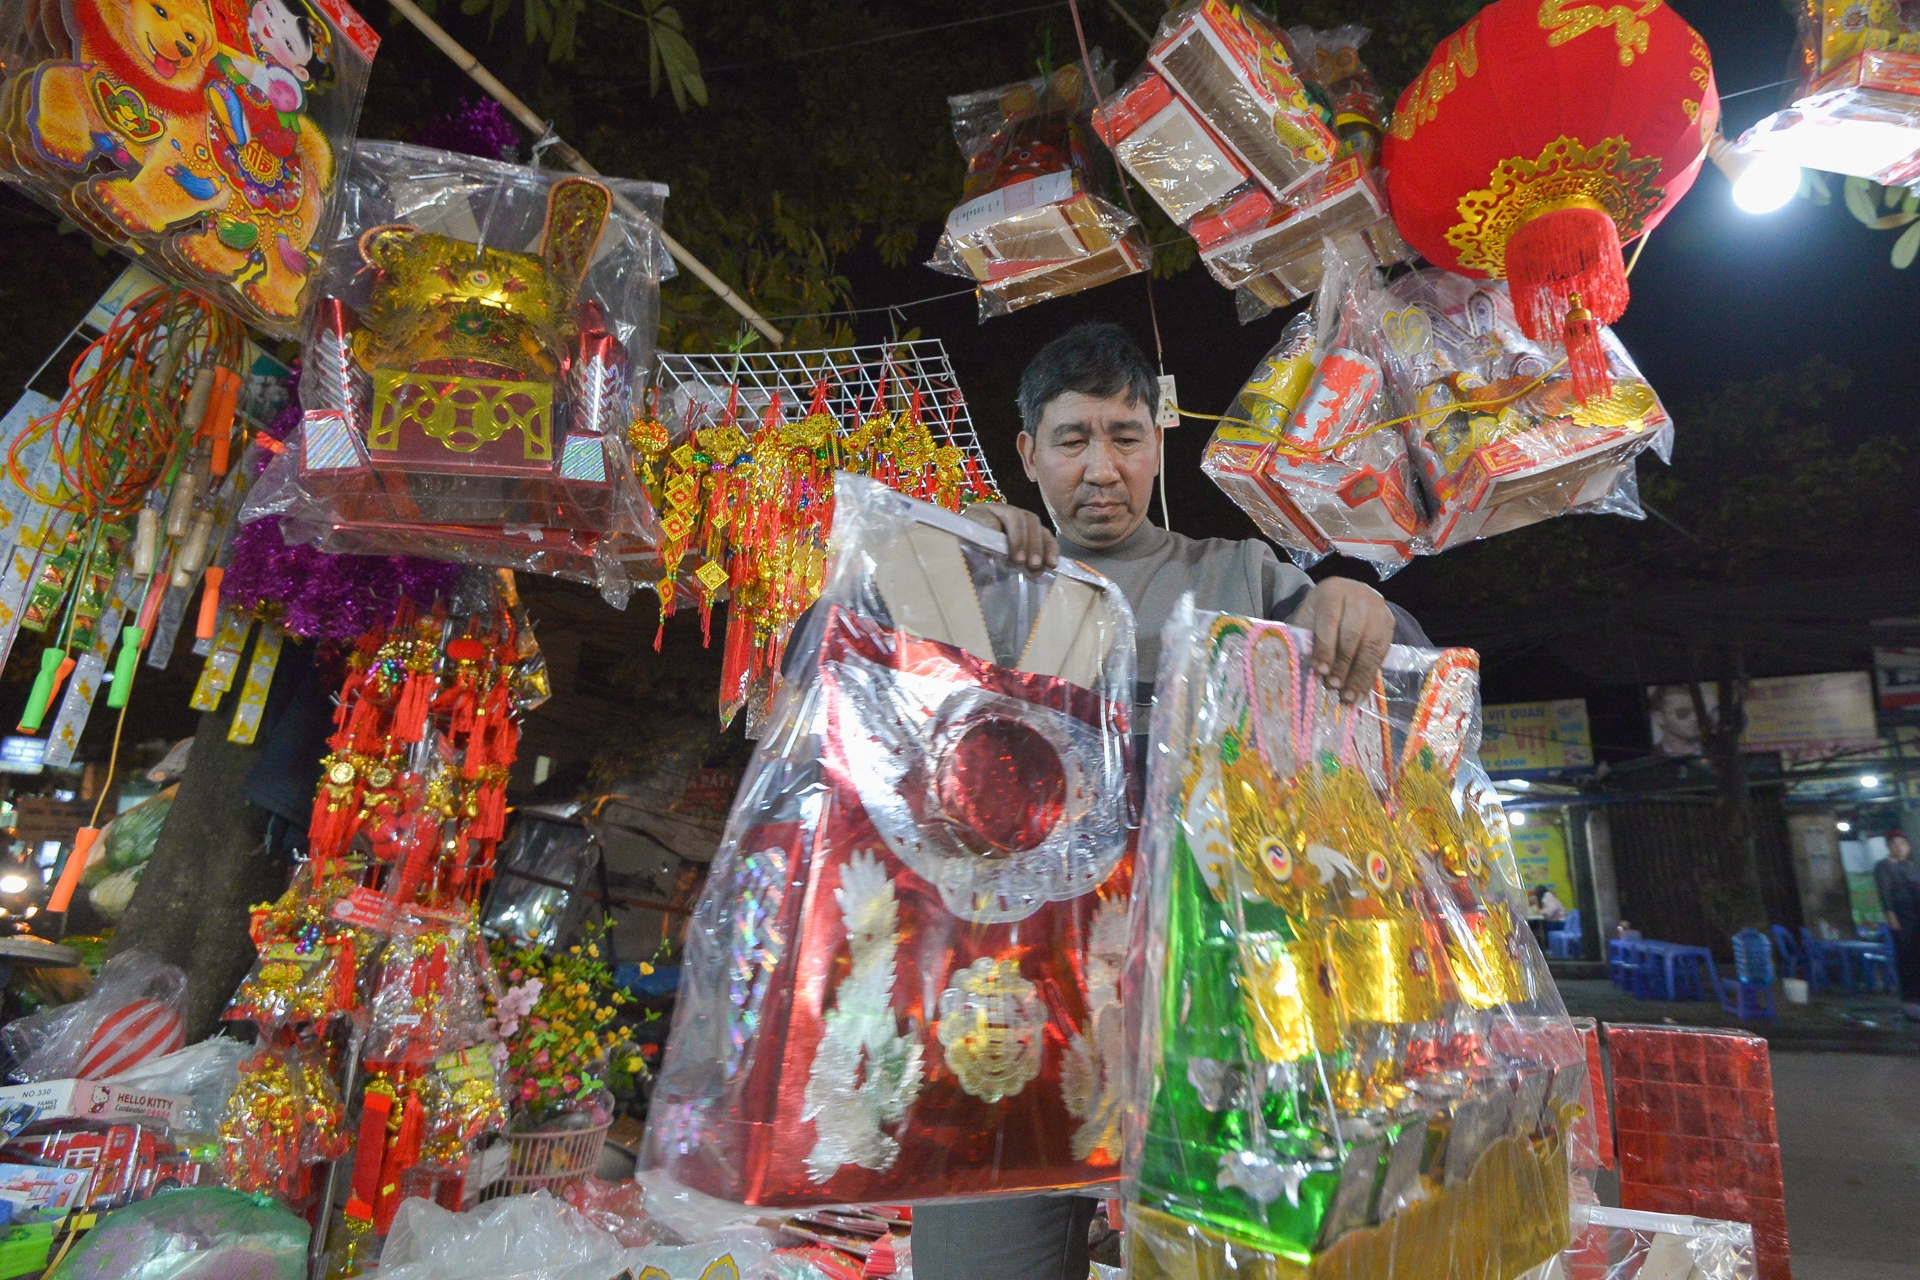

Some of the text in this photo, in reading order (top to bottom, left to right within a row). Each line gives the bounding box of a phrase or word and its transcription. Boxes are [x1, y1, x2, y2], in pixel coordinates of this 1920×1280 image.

[22, 1088, 52, 1099] NO.330
[117, 1093, 174, 1110] HELLO KITTY
